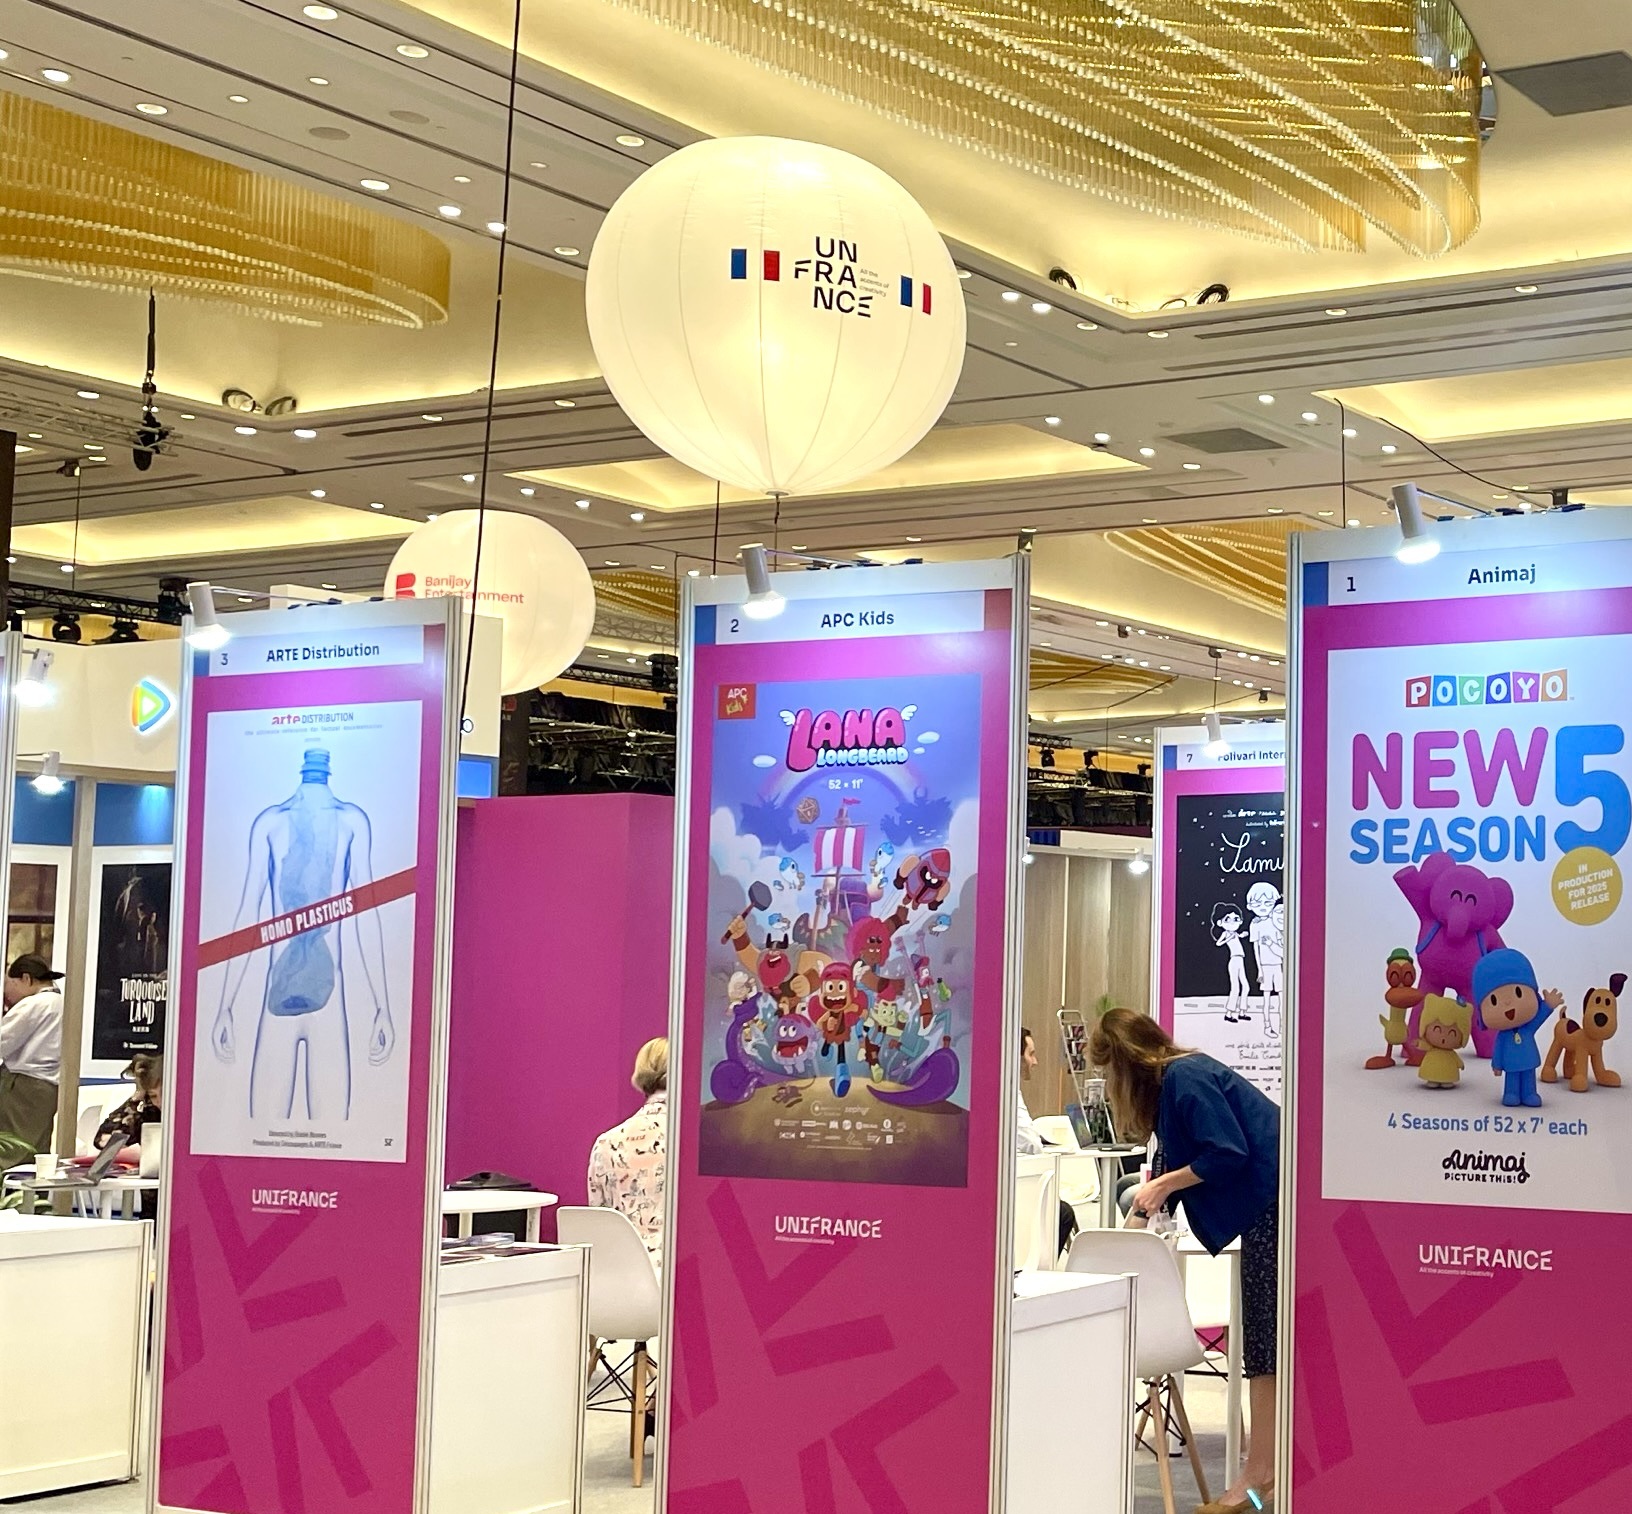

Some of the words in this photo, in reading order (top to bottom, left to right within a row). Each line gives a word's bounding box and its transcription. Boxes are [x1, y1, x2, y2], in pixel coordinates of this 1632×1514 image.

[815, 236, 858, 263] UN
[794, 259, 857, 289] FRA
[425, 575, 472, 589] Banijay
[1346, 577, 1357, 593] 1
[1467, 564, 1538, 586] Animaj
[730, 619, 740, 633] 2
[821, 613, 854, 628] APC
[858, 611, 895, 626] Kids
[221, 653, 229, 666] 3
[266, 648, 299, 663] ARTE
[302, 643, 380, 661] Distribution
[727, 687, 748, 699] APC
[1406, 670, 1568, 707] POCOYO
[271, 713, 301, 725] arte
[301, 712, 354, 724] DISTRIBUTION
[786, 707, 906, 772] LANA
[817, 747, 909, 768] LONGBEARD
[1186, 753, 1193, 763] 7
[1259, 750, 1285, 760] Inter
[1351, 726, 1549, 811] NEW
[828, 779, 841, 790] 52
[1553, 724, 1632, 857] 5
[1349, 815, 1546, 865] SEASON
[1578, 863, 1588, 874] IN
[1558, 868, 1614, 891] PRODUCTION
[1568, 887, 1586, 900] FOR
[1587, 881, 1608, 895] 2025
[1571, 892, 1610, 911] RELEASE
[260, 917, 294, 944] HOMO
[295, 896, 354, 931] PLASTICUS
[120, 977, 168, 1003] TURQUOISE
[129, 1001, 155, 1024] LAND
[1388, 1112, 1397, 1128] 4
[1401, 1113, 1469, 1132] Seasons
[1474, 1116, 1490, 1132] of
[1494, 1116, 1514, 1133] 52
[1517, 1120, 1526, 1133] x
[1530, 1117, 1543, 1134] 7'
[1549, 1119, 1588, 1136] each
[1442, 1149, 1530, 1184] Animaj
